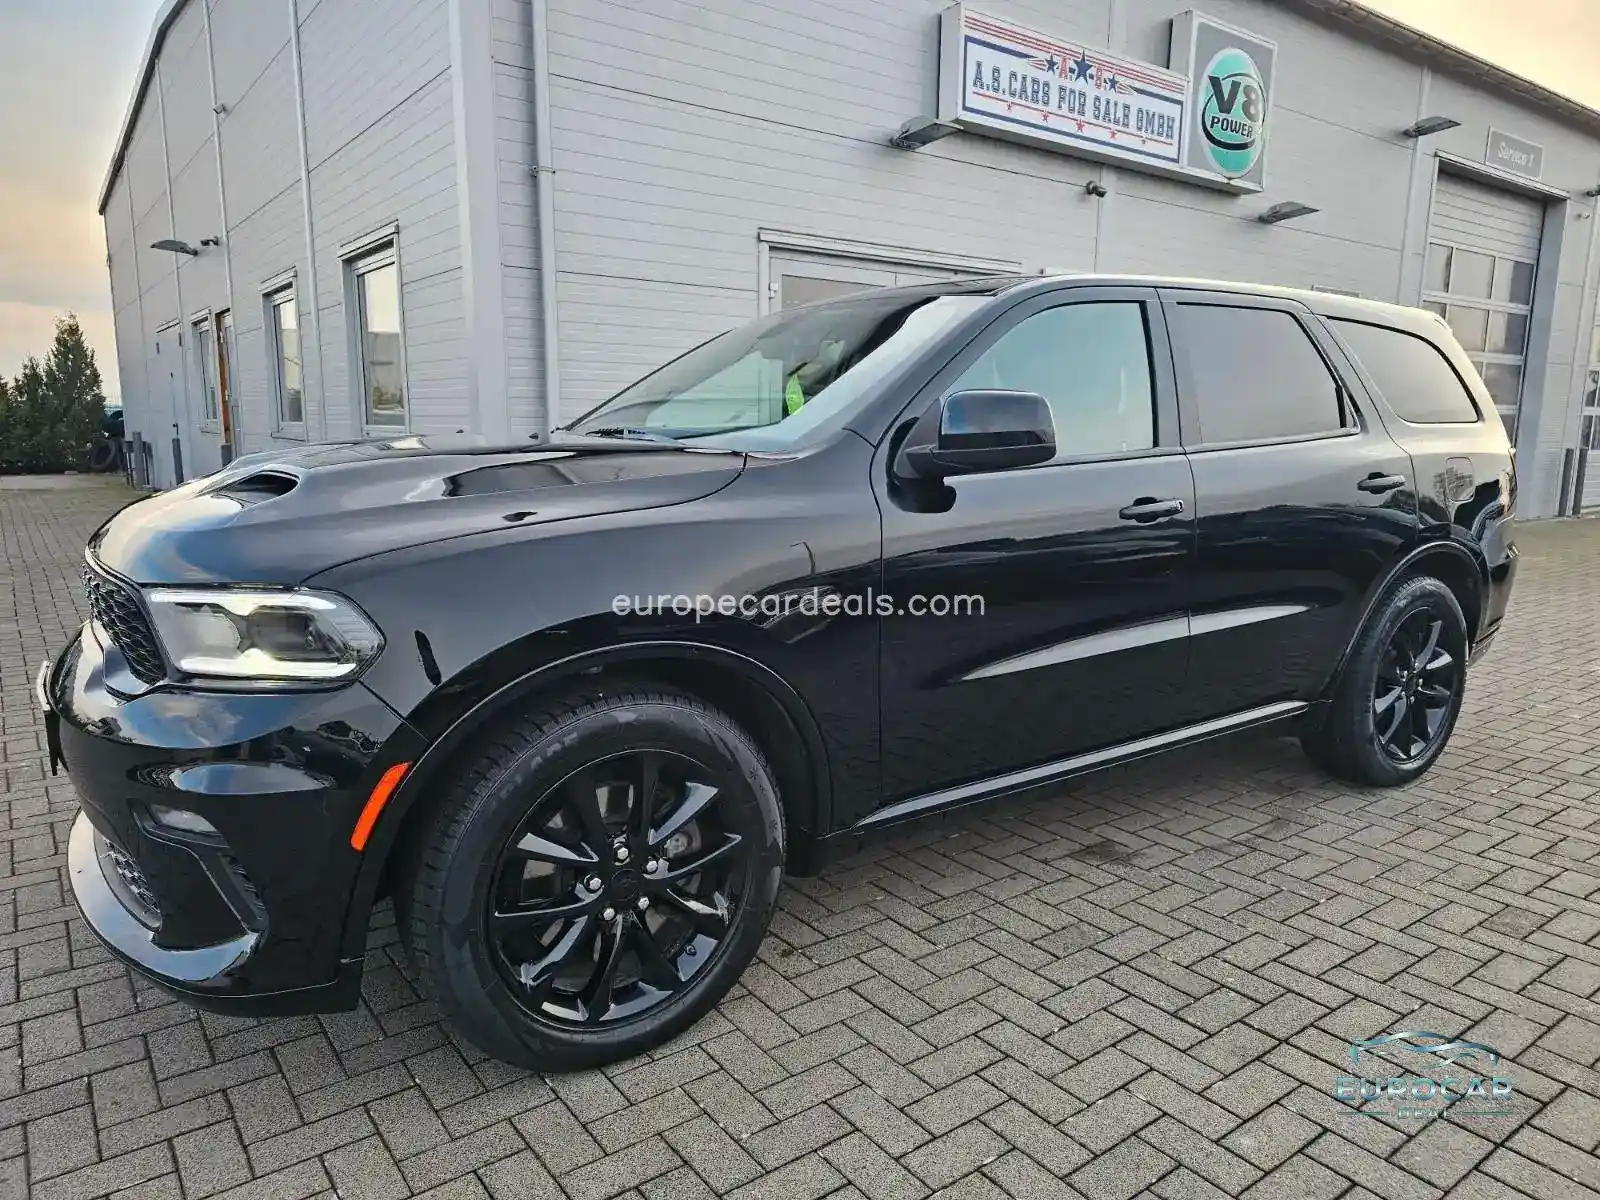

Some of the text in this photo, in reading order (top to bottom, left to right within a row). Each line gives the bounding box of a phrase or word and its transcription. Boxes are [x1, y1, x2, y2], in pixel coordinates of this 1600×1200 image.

[1058, 85, 1087, 117] FOR
[1093, 95, 1130, 129] SALE
[1136, 107, 1175, 140] GMBH
[1208, 75, 1260, 123] V8
[1210, 115, 1254, 139] POWER
[1497, 141, 1528, 166] Service
